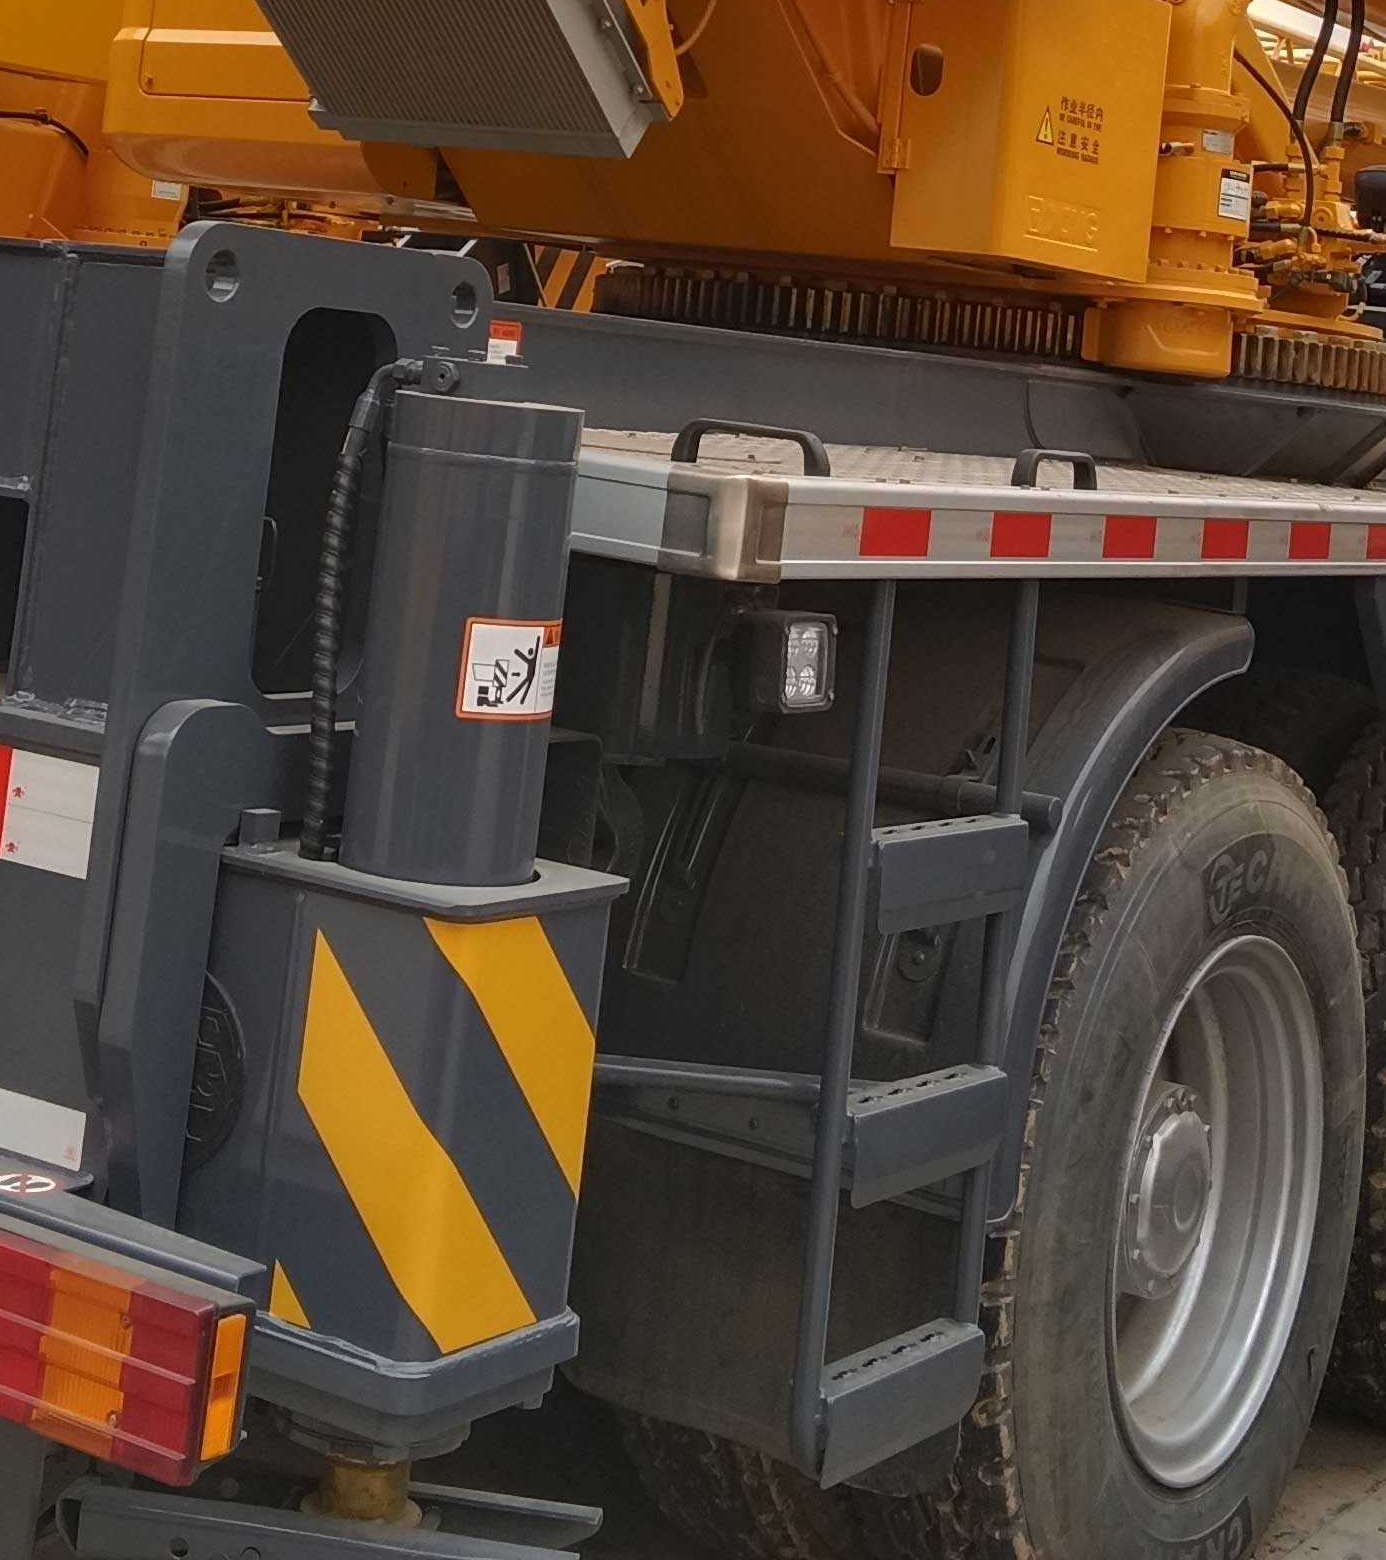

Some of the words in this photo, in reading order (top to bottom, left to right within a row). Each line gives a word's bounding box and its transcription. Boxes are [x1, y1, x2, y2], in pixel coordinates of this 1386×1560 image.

[1060, 95, 1103, 122] 作业半径内
